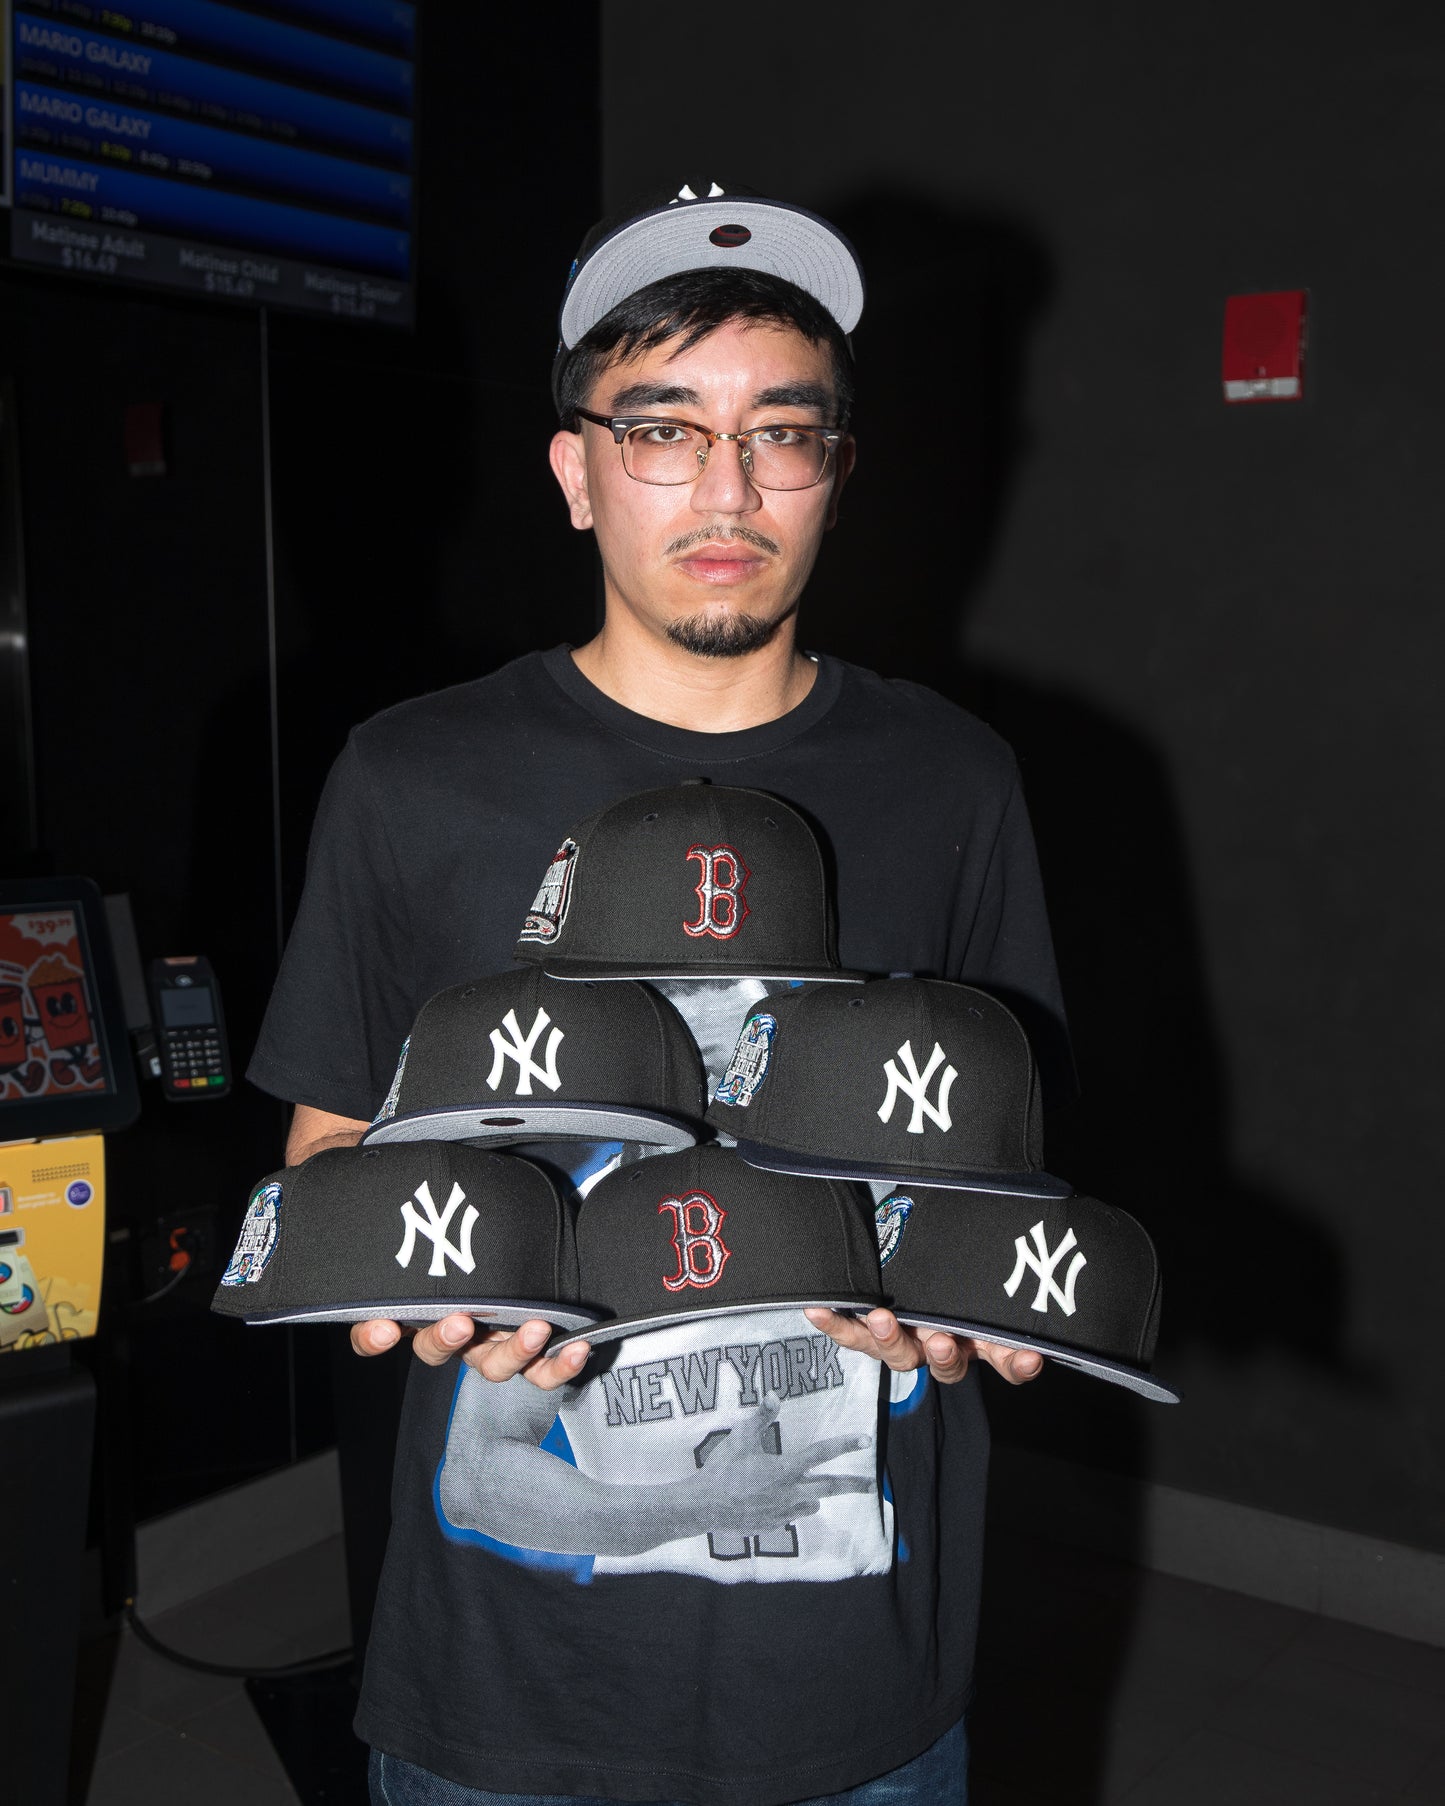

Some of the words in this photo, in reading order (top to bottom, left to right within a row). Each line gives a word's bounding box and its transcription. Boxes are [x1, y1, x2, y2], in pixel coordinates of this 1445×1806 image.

[20, 22, 83, 58] MARIO
[85, 41, 152, 76] GALAXY
[20, 90, 83, 125] MARIO
[85, 107, 152, 140] GALAXY
[20, 157, 99, 193] MUMMY
[32, 219, 99, 251] Matinee
[101, 234, 146, 259] Adult
[179, 247, 239, 275] Matinee
[241, 259, 280, 285] Child
[304, 271, 358, 296] Matinee
[683, 842, 752, 941] B
[486, 1006, 565, 1096] NY
[877, 1039, 959, 1134] NY
[395, 1180, 480, 1277] NY
[657, 1188, 733, 1293] B
[1003, 1220, 1088, 1317] NY
[600, 1347, 721, 1427] NEW
[725, 1335, 845, 1407] YORK
